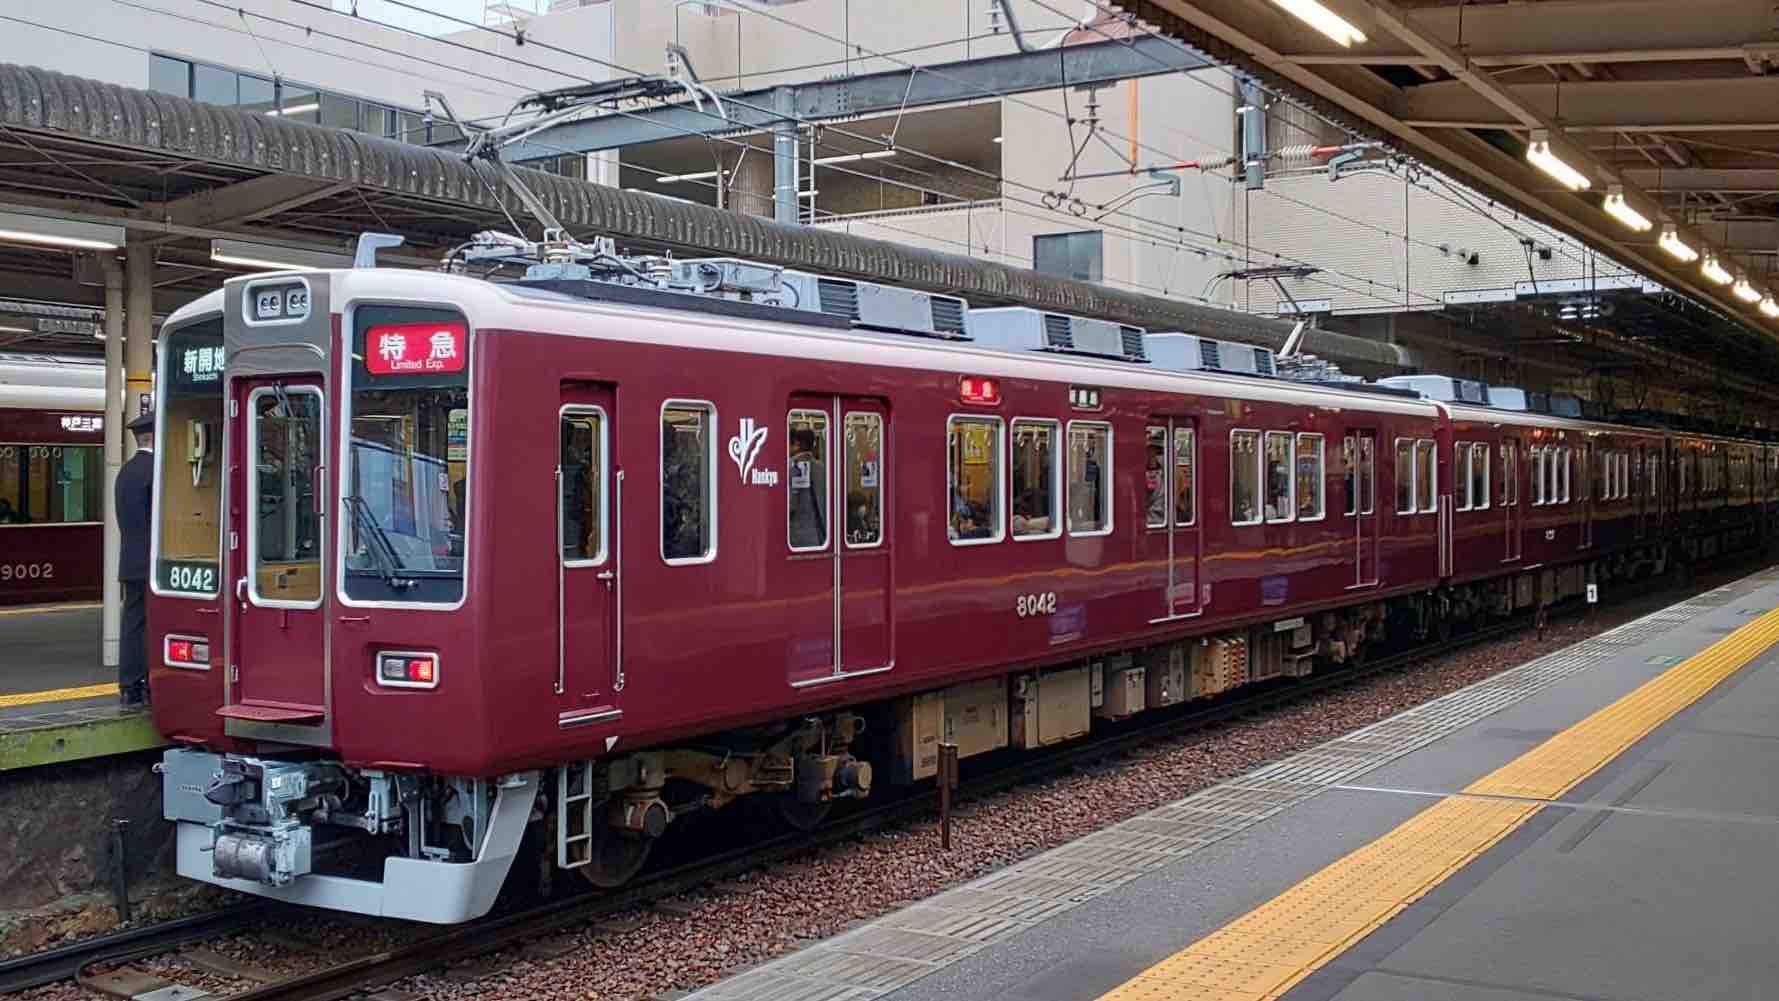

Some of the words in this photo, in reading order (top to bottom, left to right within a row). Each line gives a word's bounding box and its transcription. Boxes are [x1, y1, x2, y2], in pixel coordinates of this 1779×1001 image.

[379, 331, 456, 361] 特急
[390, 359, 423, 370] Limited
[425, 358, 445, 372] Exp.
[751, 467, 779, 487] Hankyu
[0, 562, 54, 580] 9002
[170, 566, 214, 591] 8042
[1016, 591, 1057, 617] 8042
